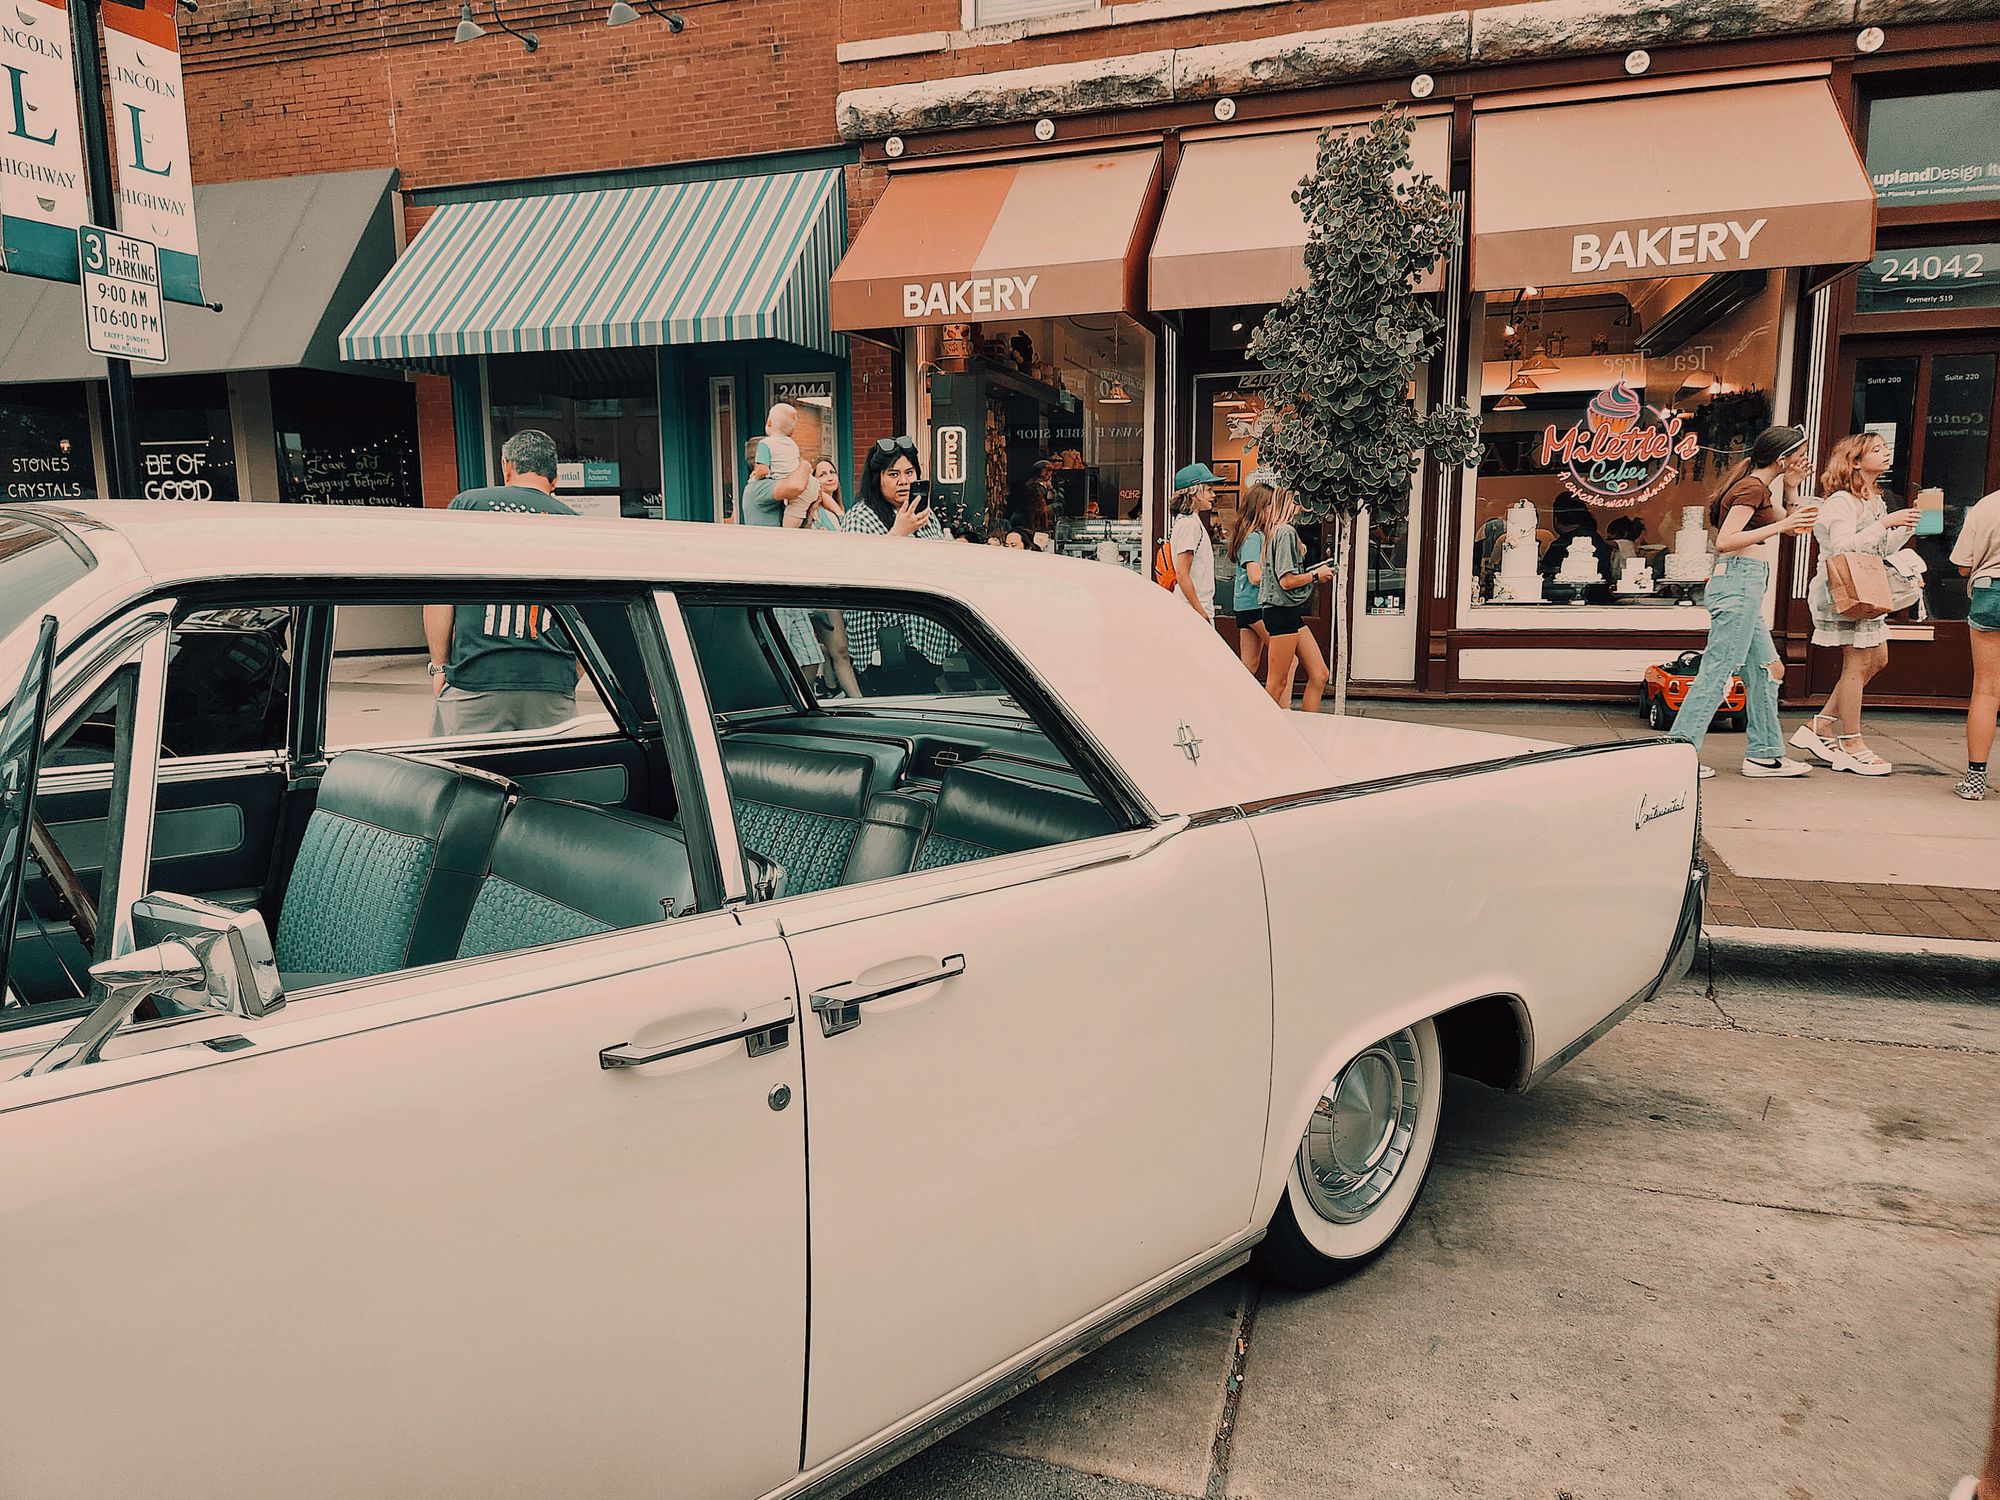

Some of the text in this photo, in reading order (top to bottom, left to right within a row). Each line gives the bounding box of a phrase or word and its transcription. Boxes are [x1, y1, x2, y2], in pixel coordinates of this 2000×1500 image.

[1, 25, 64, 61] NCOLN
[0, 62, 58, 147] L
[122, 102, 172, 177] L
[0, 156, 76, 190] HIGHWAY
[121, 187, 188, 218] HIGHWAY
[85, 233, 104, 270] 3
[1571, 218, 1768, 273] BAKERY
[109, 256, 155, 282] PARKING
[1881, 253, 1984, 282] 24042
[98, 282, 148, 308] 9:00 AM
[903, 275, 1039, 318] BAKERY
[1906, 296, 1938, 304] Formerly
[92, 305, 158, 333] TO 6:00 PM
[1867, 376, 1902, 385] Suite 200
[1965, 373, 1980, 381] 220
[779, 383, 826, 399] 24044
[1541, 417, 1700, 466] Milette's
[12, 457, 70, 473] STONES
[145, 453, 206, 475] BE OF
[307, 454, 380, 474] Leave old
[945, 430, 958, 480] OPEN
[559, 471, 580, 481] ntial
[1589, 460, 1649, 482] Cakes
[7, 482, 82, 498] CRYSTALS
[144, 480, 213, 501] GOOD
